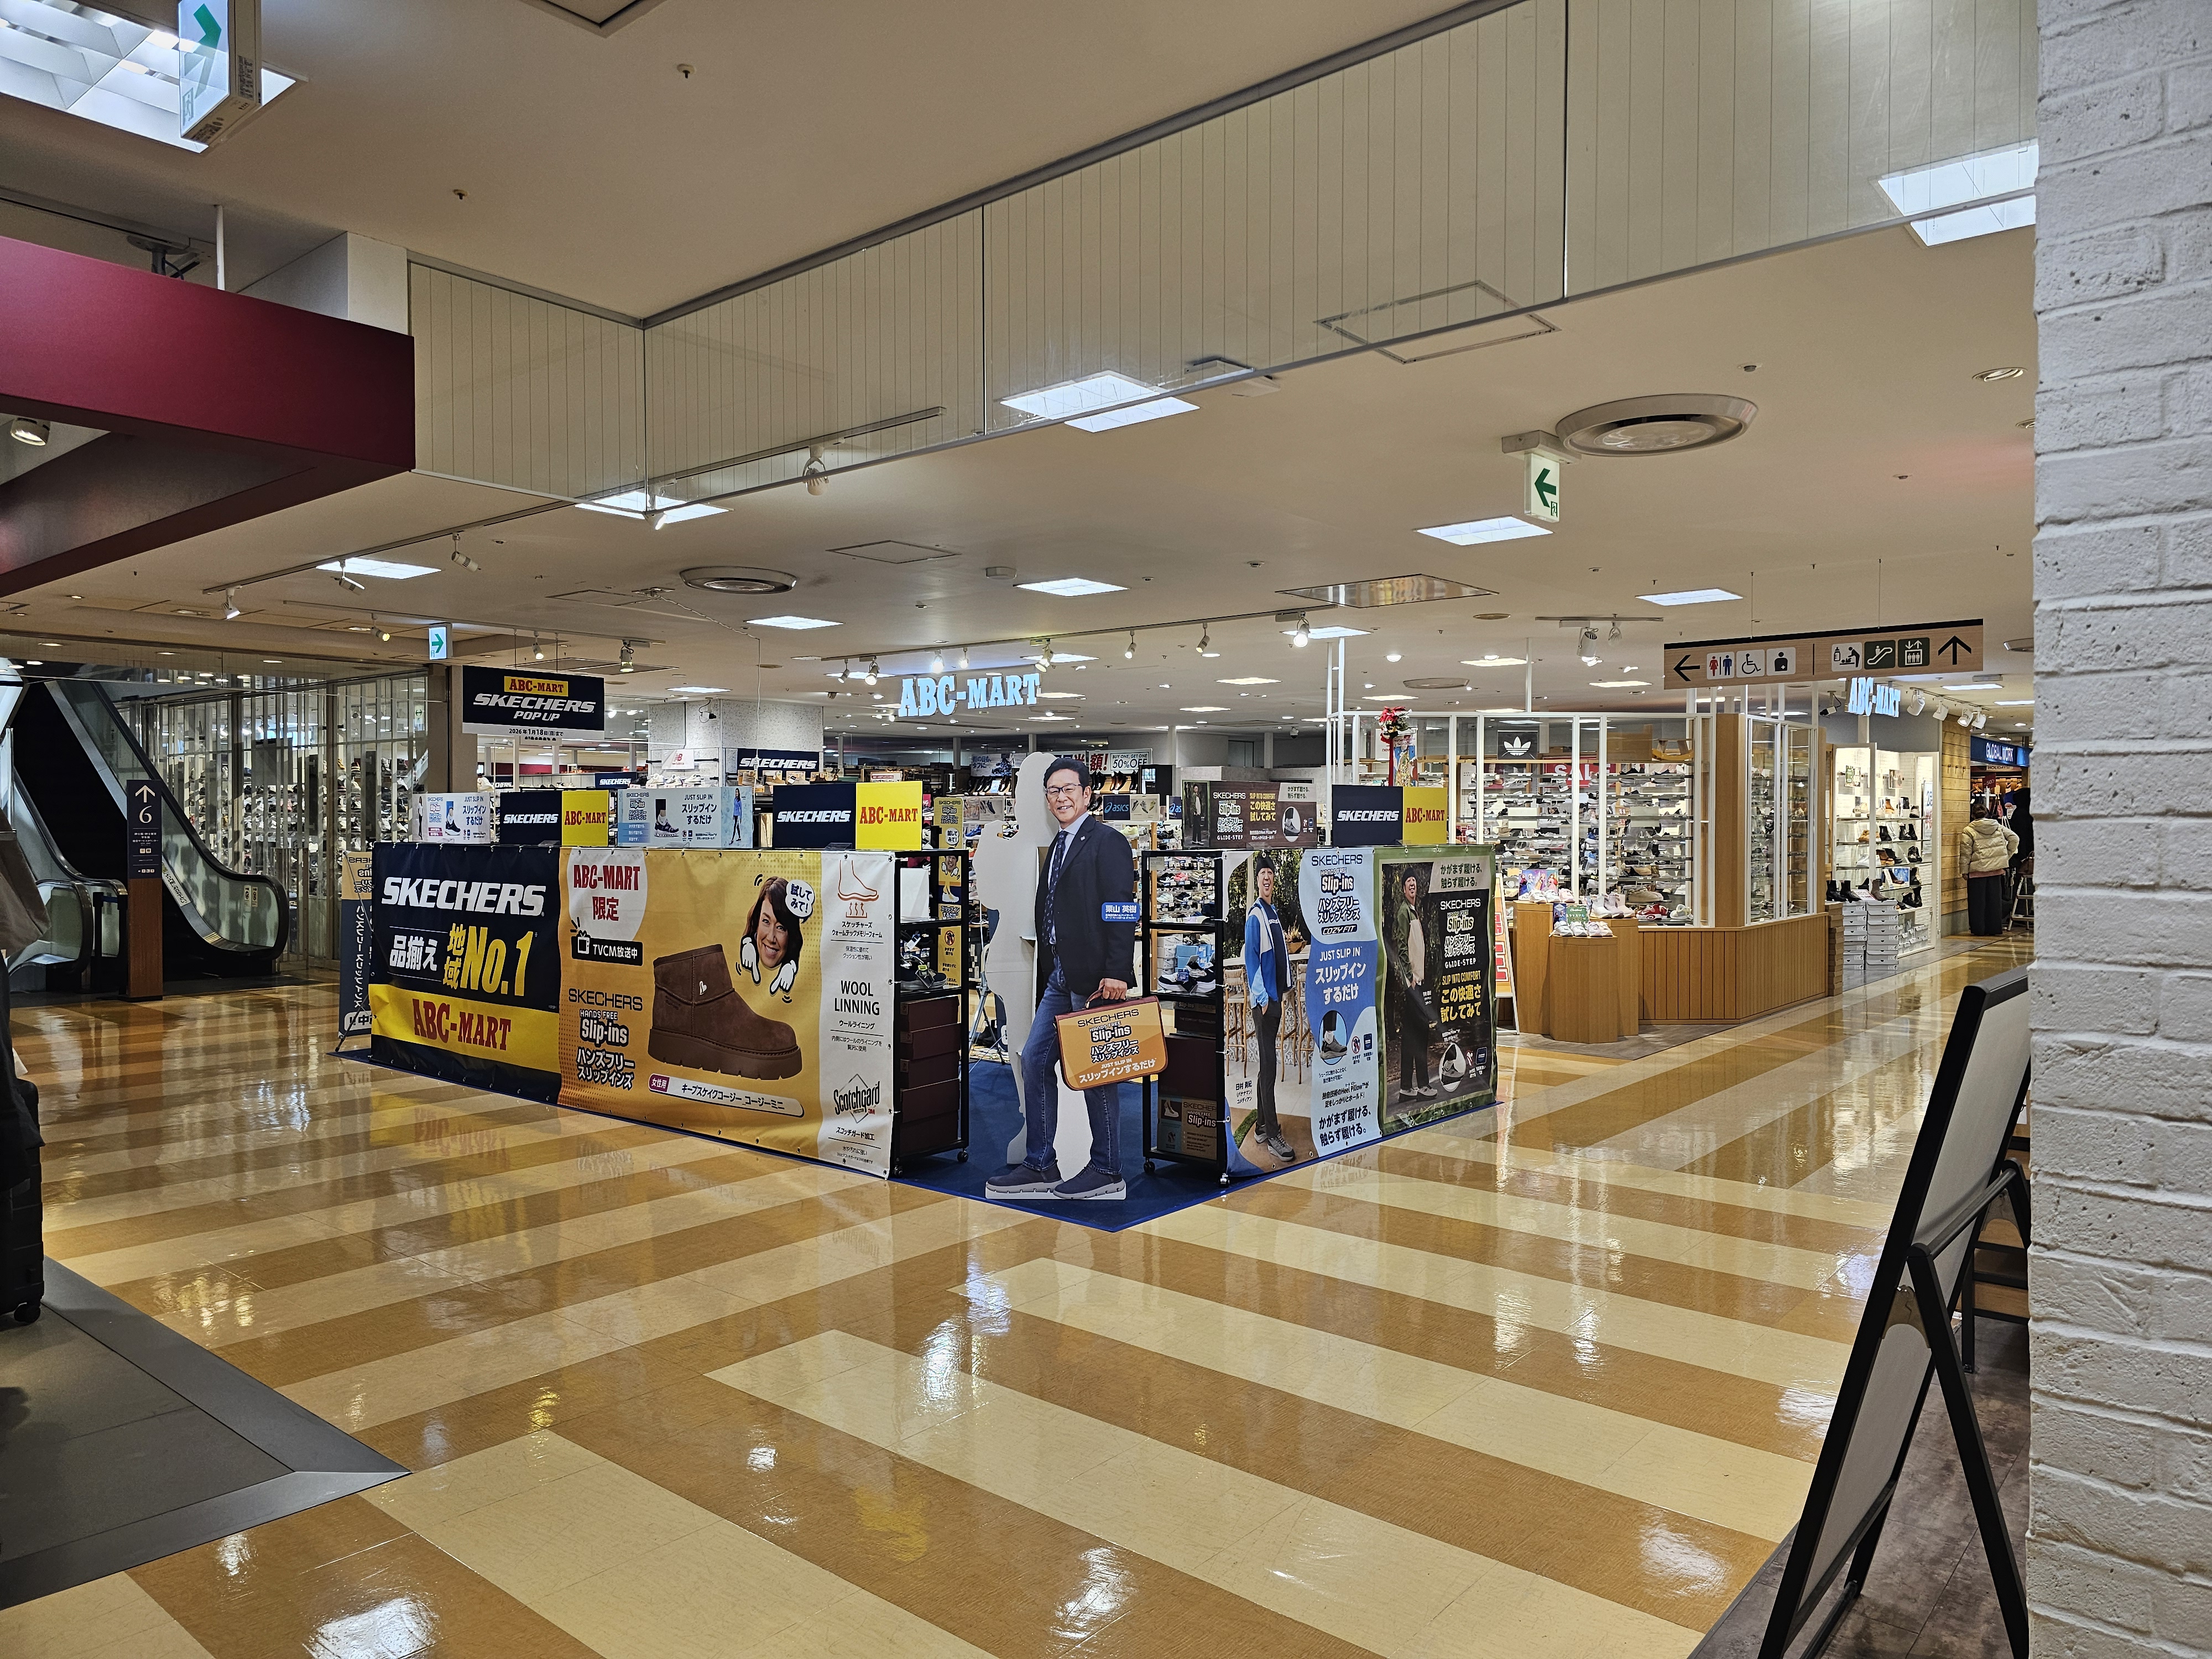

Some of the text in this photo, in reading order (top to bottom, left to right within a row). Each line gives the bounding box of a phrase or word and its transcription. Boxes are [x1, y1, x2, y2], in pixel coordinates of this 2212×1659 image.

[509, 679, 564, 693] ABC-MART
[898, 673, 1041, 717] ABC-MART
[1848, 677, 1901, 717] ABC-MART
[473, 693, 596, 713] SKECHERS
[514, 711, 540, 719] POP
[1986, 742, 2013, 761] GLOBAL WORK
[739, 758, 817, 769] SKECHERS
[1090, 753, 1108, 771] 額!
[1113, 758, 1147, 769] 50%OFF
[463, 805, 486, 815] スリップイン
[682, 803, 717, 813] スリップイン
[1219, 805, 1240, 815] Slip-ins
[1250, 801, 1276, 810] この快適さ
[139, 806, 152, 823] 6
[466, 816, 483, 825] するだけ
[503, 813, 559, 824] SKECHERS
[565, 810, 606, 825] ABC-MART
[687, 815, 712, 825] するだけ
[777, 810, 851, 822] SKECHERS
[859, 807, 918, 824] ABC-MART
[1250, 812, 1276, 822] 試してみて
[1337, 810, 1399, 822] SKECHERS
[1405, 807, 1444, 823] ABC-MART
[1312, 854, 1363, 867] SKECHERS
[1441, 863, 1482, 874] かがまず履ける、
[573, 865, 640, 890] ABC-MART
[1322, 875, 1353, 894] Slip-ins
[1441, 877, 1477, 889] 触らず履ける。
[381, 877, 546, 916] SKECHERS
[791, 883, 812, 901] 試して
[592, 896, 619, 921] 限定
[791, 898, 808, 914] みて!
[1105, 905, 1137, 913] 栗山 英樹
[1318, 896, 1359, 911] ハンズフリー
[1440, 898, 1481, 910] SKECHERS
[1318, 908, 1360, 924] スリップインズ
[1322, 926, 1343, 935] COZY
[1448, 916, 1473, 932] Slip-ins
[832, 930, 883, 938] ウォームテックメモリーフォーム
[1444, 933, 1475, 947] ハンズフリー
[389, 935, 437, 972] 品揃え
[593, 944, 638, 959] TVCM放送中
[1319, 947, 1360, 962] JUST SLIP IN
[1444, 943, 1475, 958] スリップインズ
[1315, 962, 1366, 984] スリップイン
[1442, 971, 1481, 985] SLIP INTO COMFORT
[841, 980, 873, 997] WOOL
[1323, 983, 1359, 1005] するだけ
[1441, 984, 1481, 1004] この快適さ
[568, 988, 643, 1011] SKECHERS
[834, 998, 880, 1015] LINNING
[580, 1009, 618, 1020] HANDS FREE
[1078, 1009, 1139, 1027] SKECHERS
[1441, 1001, 1481, 1023] 試してみて
[412, 998, 511, 1051] ABC-MART
[582, 1018, 628, 1044] Slip-ins
[839, 1020, 875, 1029] ウールライニング
[1089, 1024, 1108, 1032] HANDS
[1092, 1026, 1131, 1042] Slip-ins
[1091, 1039, 1138, 1055] ハンズフリー
[577, 1048, 635, 1071] ハンズフリー
[1092, 1047, 1139, 1063] スリップインズ
[1079, 1060, 1156, 1084] スリップインするだけ
[1101, 1061, 1113, 1069] JUST
[578, 1065, 634, 1089] スリップインズ
[651, 1077, 667, 1089] 女性用
[1235, 1082, 1244, 1091] 日村
[833, 1081, 880, 1115] Scotchgard
[1324, 1092, 1365, 1108] 足をしっかりとホールド!
[1188, 1114, 1216, 1127] Slip-ins
[1319, 1105, 1371, 1130] かがまず履ける、
[836, 1127, 875, 1140] スコッチガード加工
[1319, 1123, 1366, 1147] 触らず履ける。
[842, 1146, 868, 1155] 水や汚れに強い
